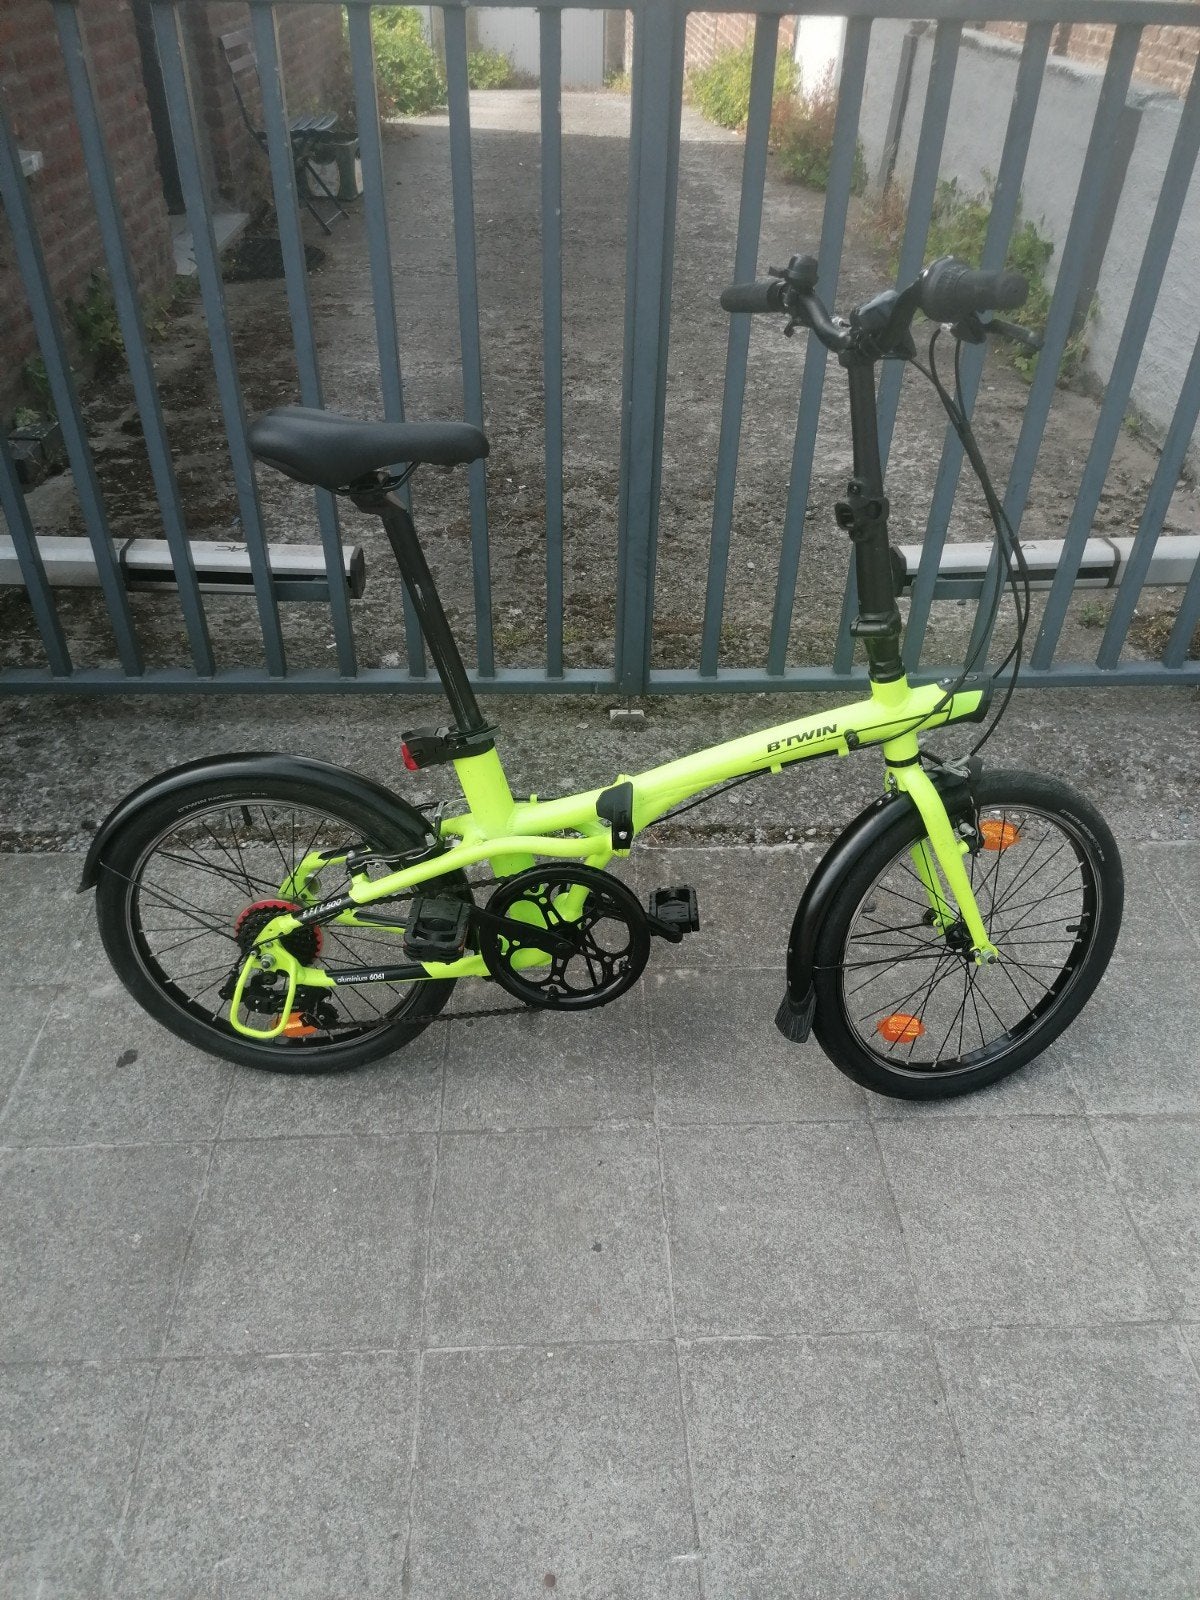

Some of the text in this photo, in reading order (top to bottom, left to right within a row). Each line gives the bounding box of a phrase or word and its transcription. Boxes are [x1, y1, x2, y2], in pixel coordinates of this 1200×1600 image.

[325, 898, 342, 910] 500
[336, 972, 385, 983] aluminium 6061
